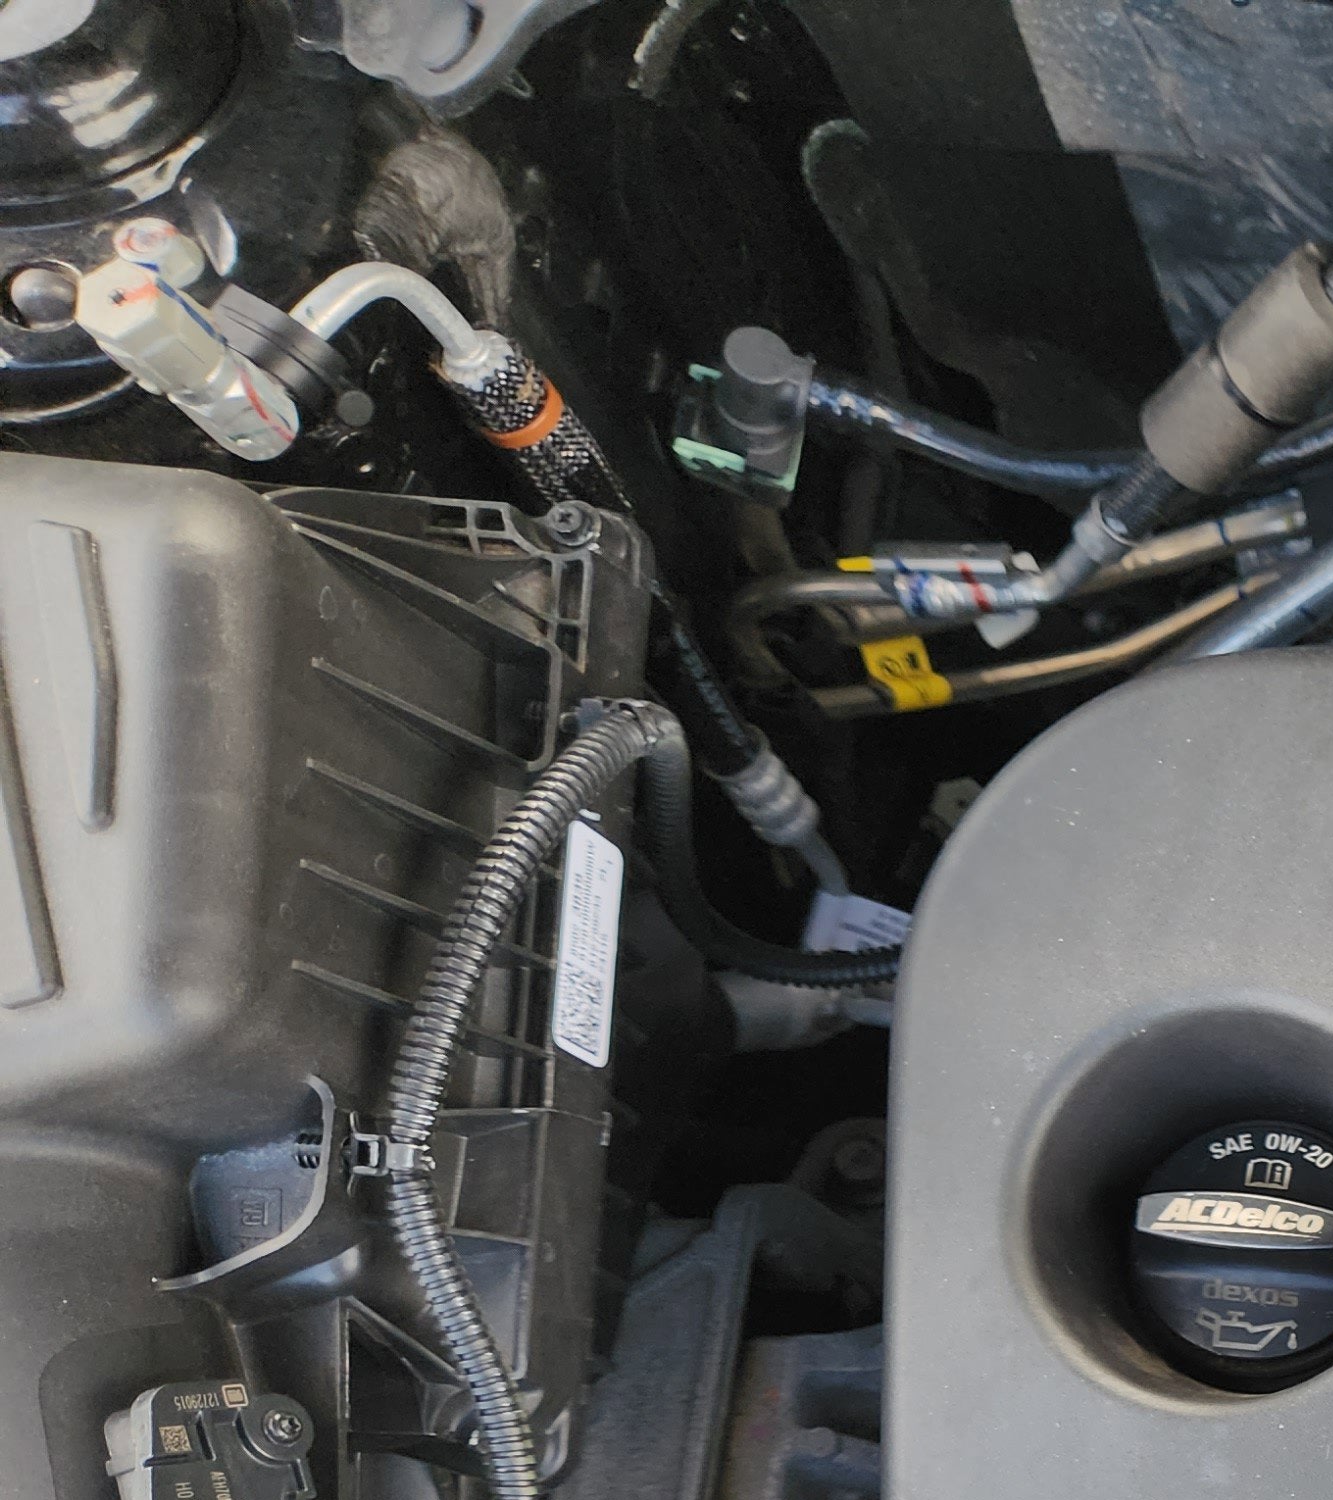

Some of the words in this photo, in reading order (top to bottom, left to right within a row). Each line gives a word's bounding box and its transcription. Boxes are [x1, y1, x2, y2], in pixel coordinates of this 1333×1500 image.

[1208, 1132, 1255, 1161] SAE
[1157, 1197, 1326, 1235] ACDelco
[1201, 1278, 1300, 1309] dexos
